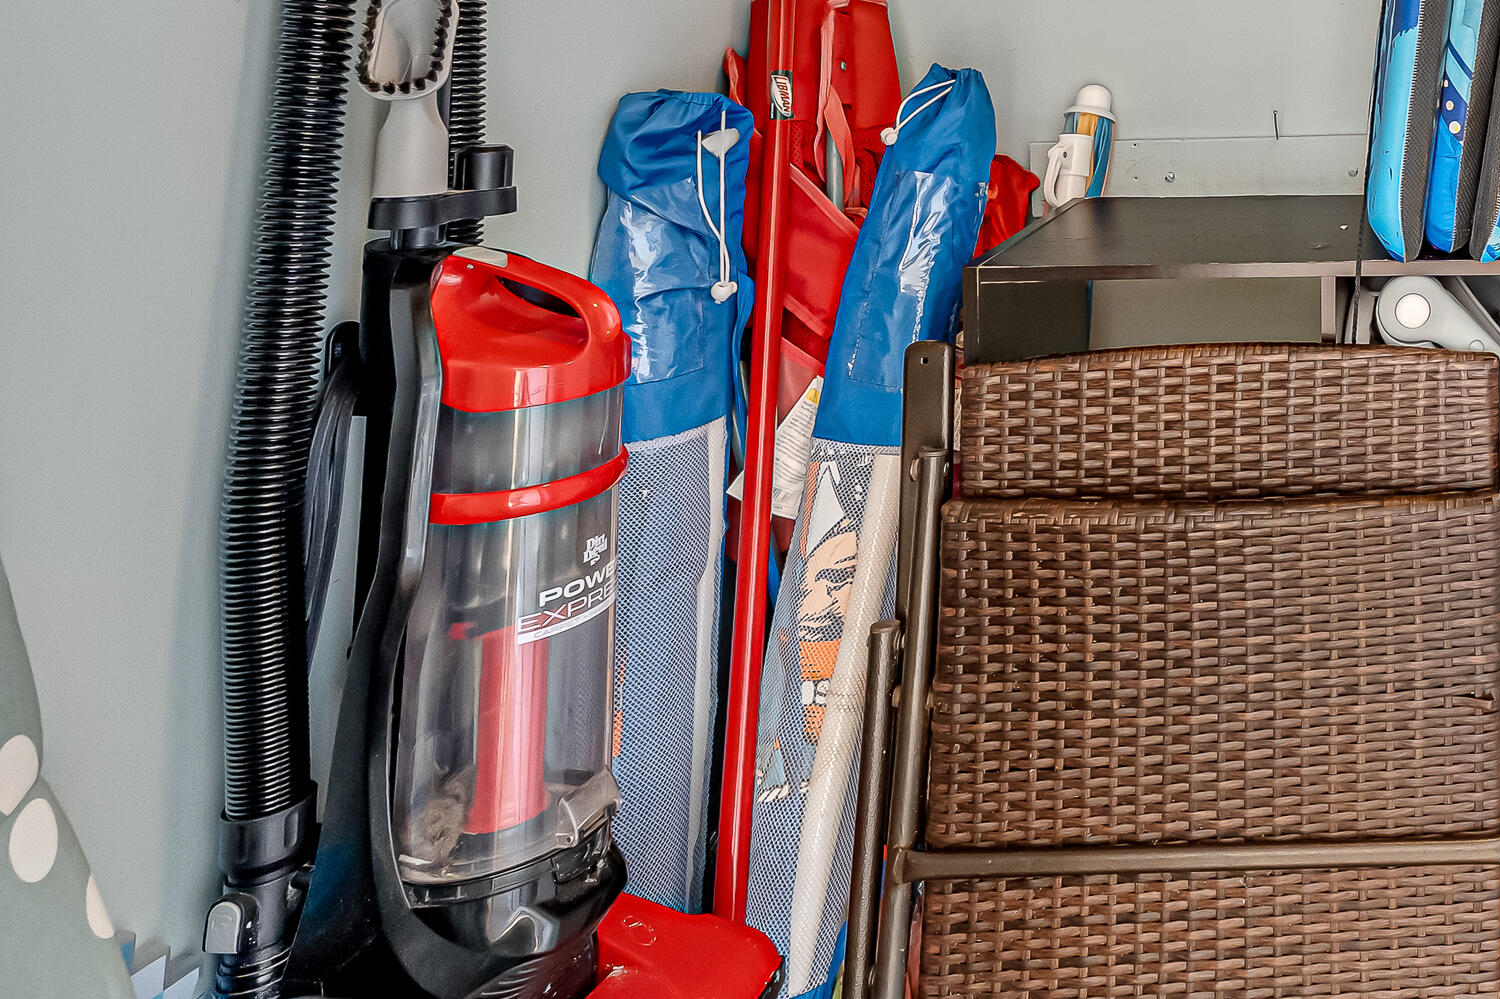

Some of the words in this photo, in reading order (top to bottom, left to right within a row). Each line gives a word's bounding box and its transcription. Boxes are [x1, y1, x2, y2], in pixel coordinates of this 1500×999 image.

[773, 76, 790, 112] LIBMAN
[518, 579, 617, 632] EXPRE
[539, 558, 617, 607] POWE
